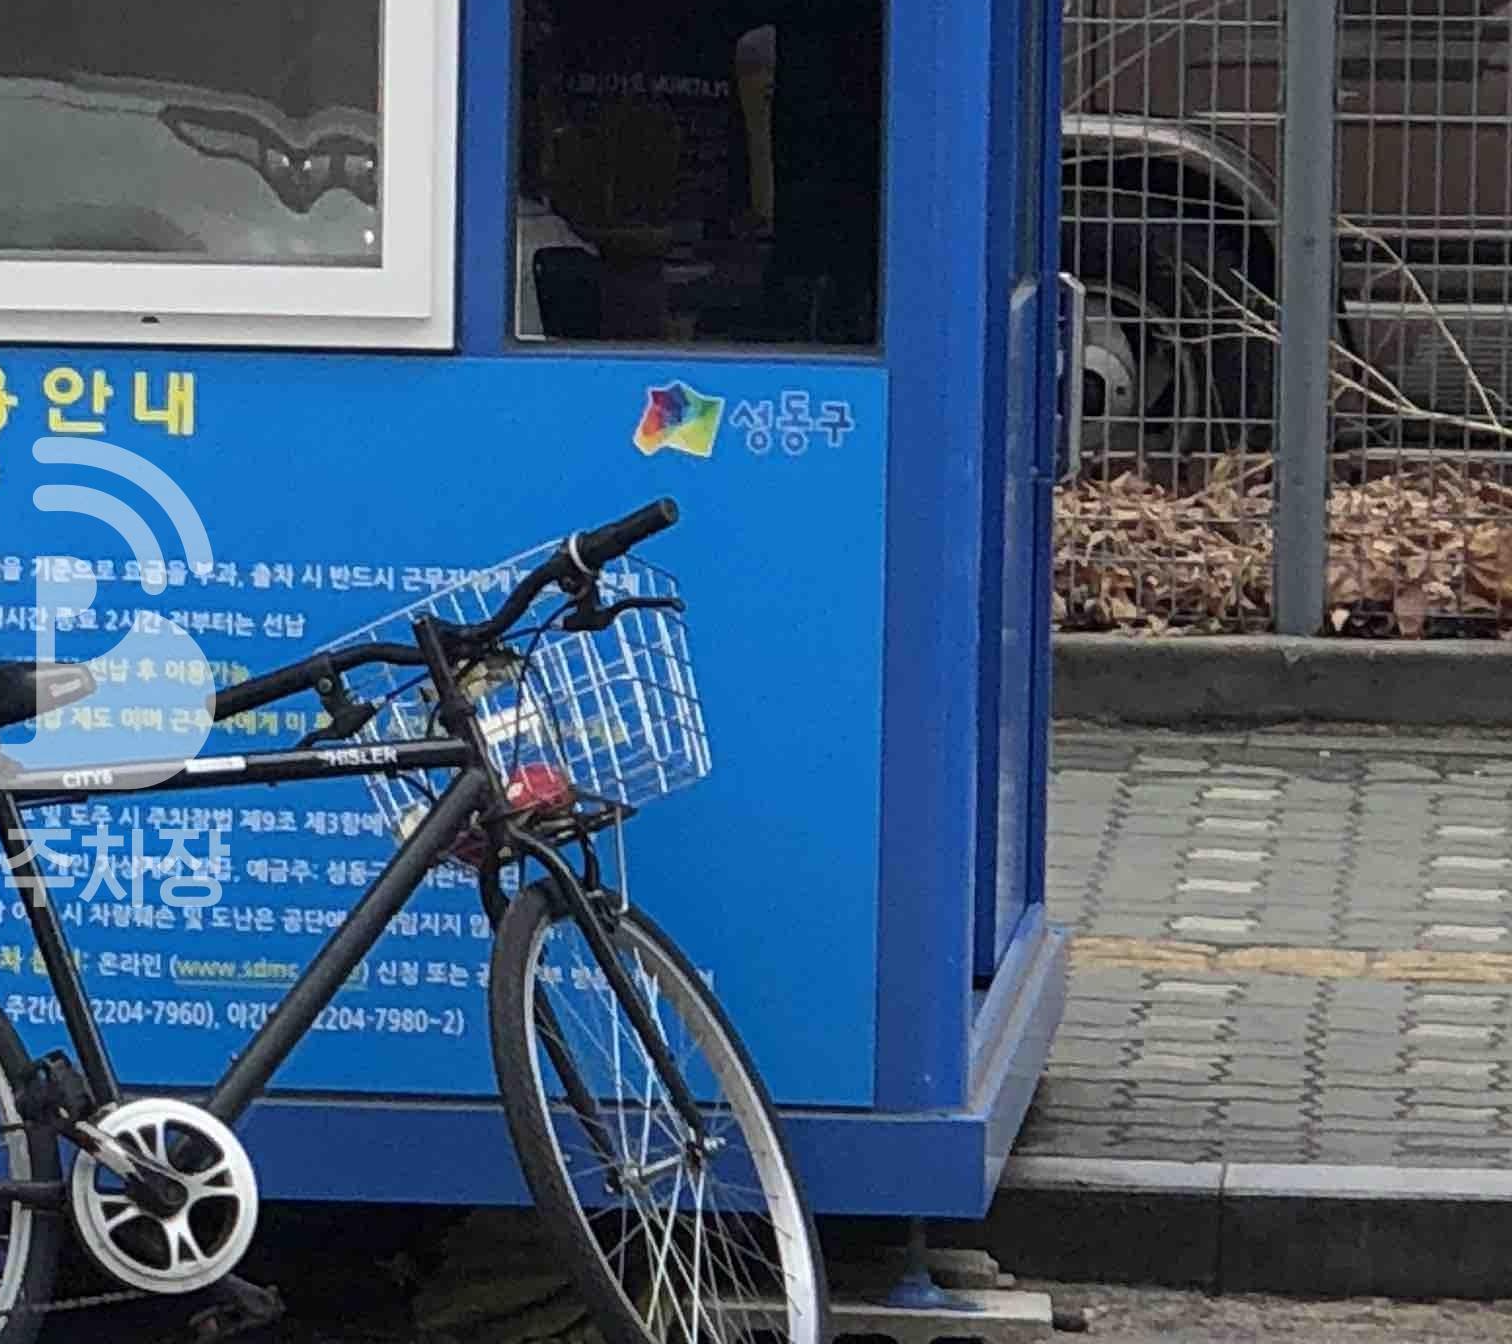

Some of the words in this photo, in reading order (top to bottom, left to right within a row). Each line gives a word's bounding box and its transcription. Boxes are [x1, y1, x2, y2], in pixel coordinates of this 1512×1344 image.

[729, 390, 856, 455] 성동구
[301, 564, 322, 591] 시
[329, 564, 395, 593] 반드시
[97, 952, 161, 978] 온라인
